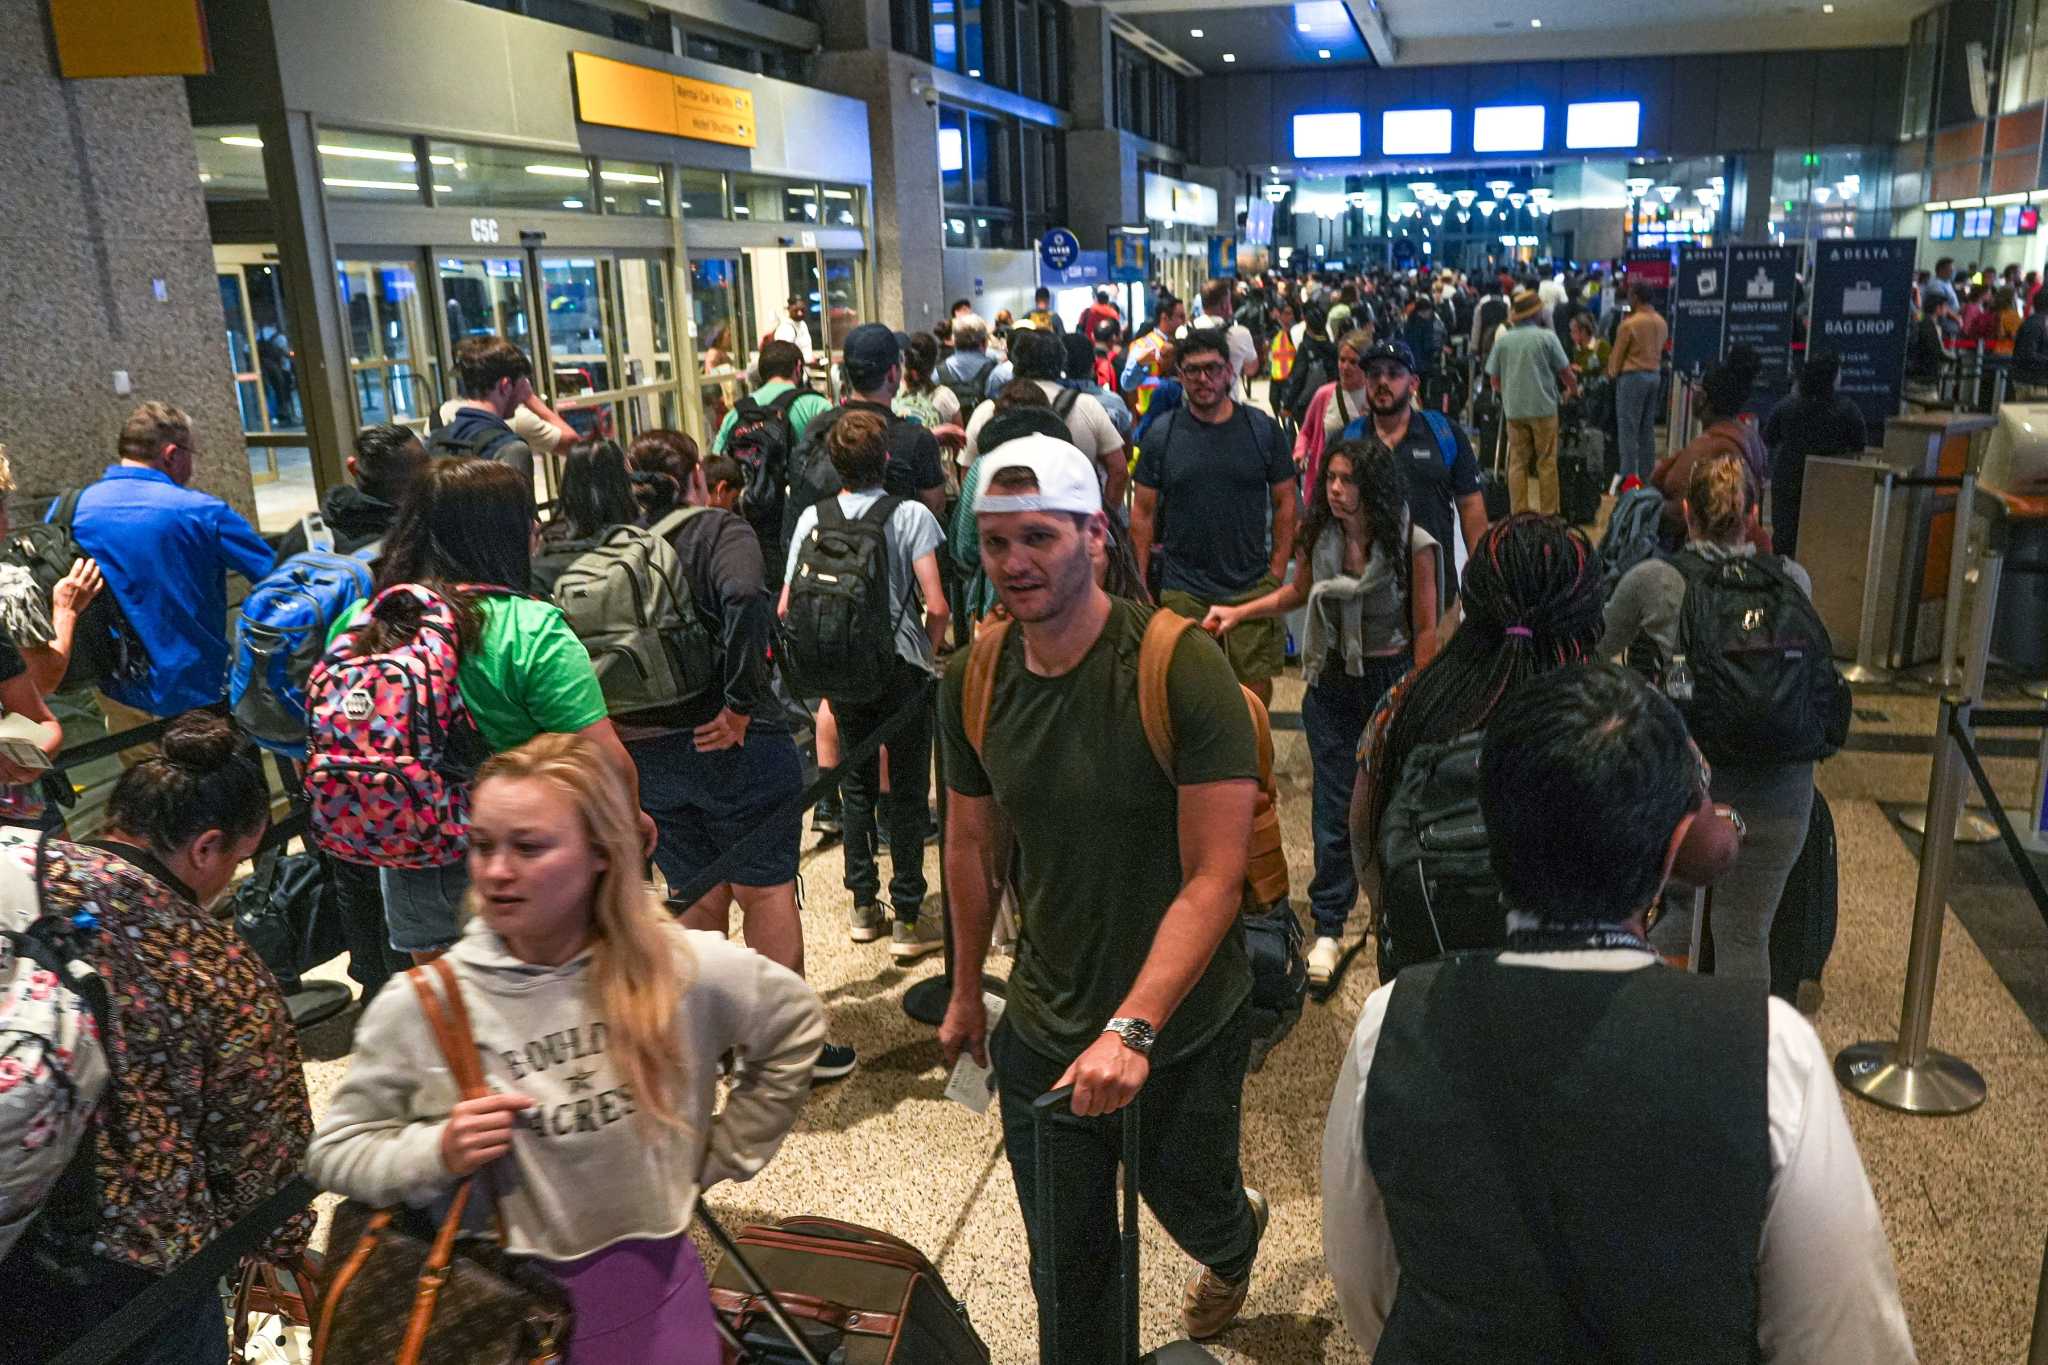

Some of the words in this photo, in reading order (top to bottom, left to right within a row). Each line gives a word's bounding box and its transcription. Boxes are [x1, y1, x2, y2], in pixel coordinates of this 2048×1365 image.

[470, 217, 499, 243] C5C
[1746, 250, 1781, 260] DELTA
[1843, 247, 1889, 260] DELTA
[1825, 319, 1853, 336] BAG
[1856, 319, 1895, 335] DROP
